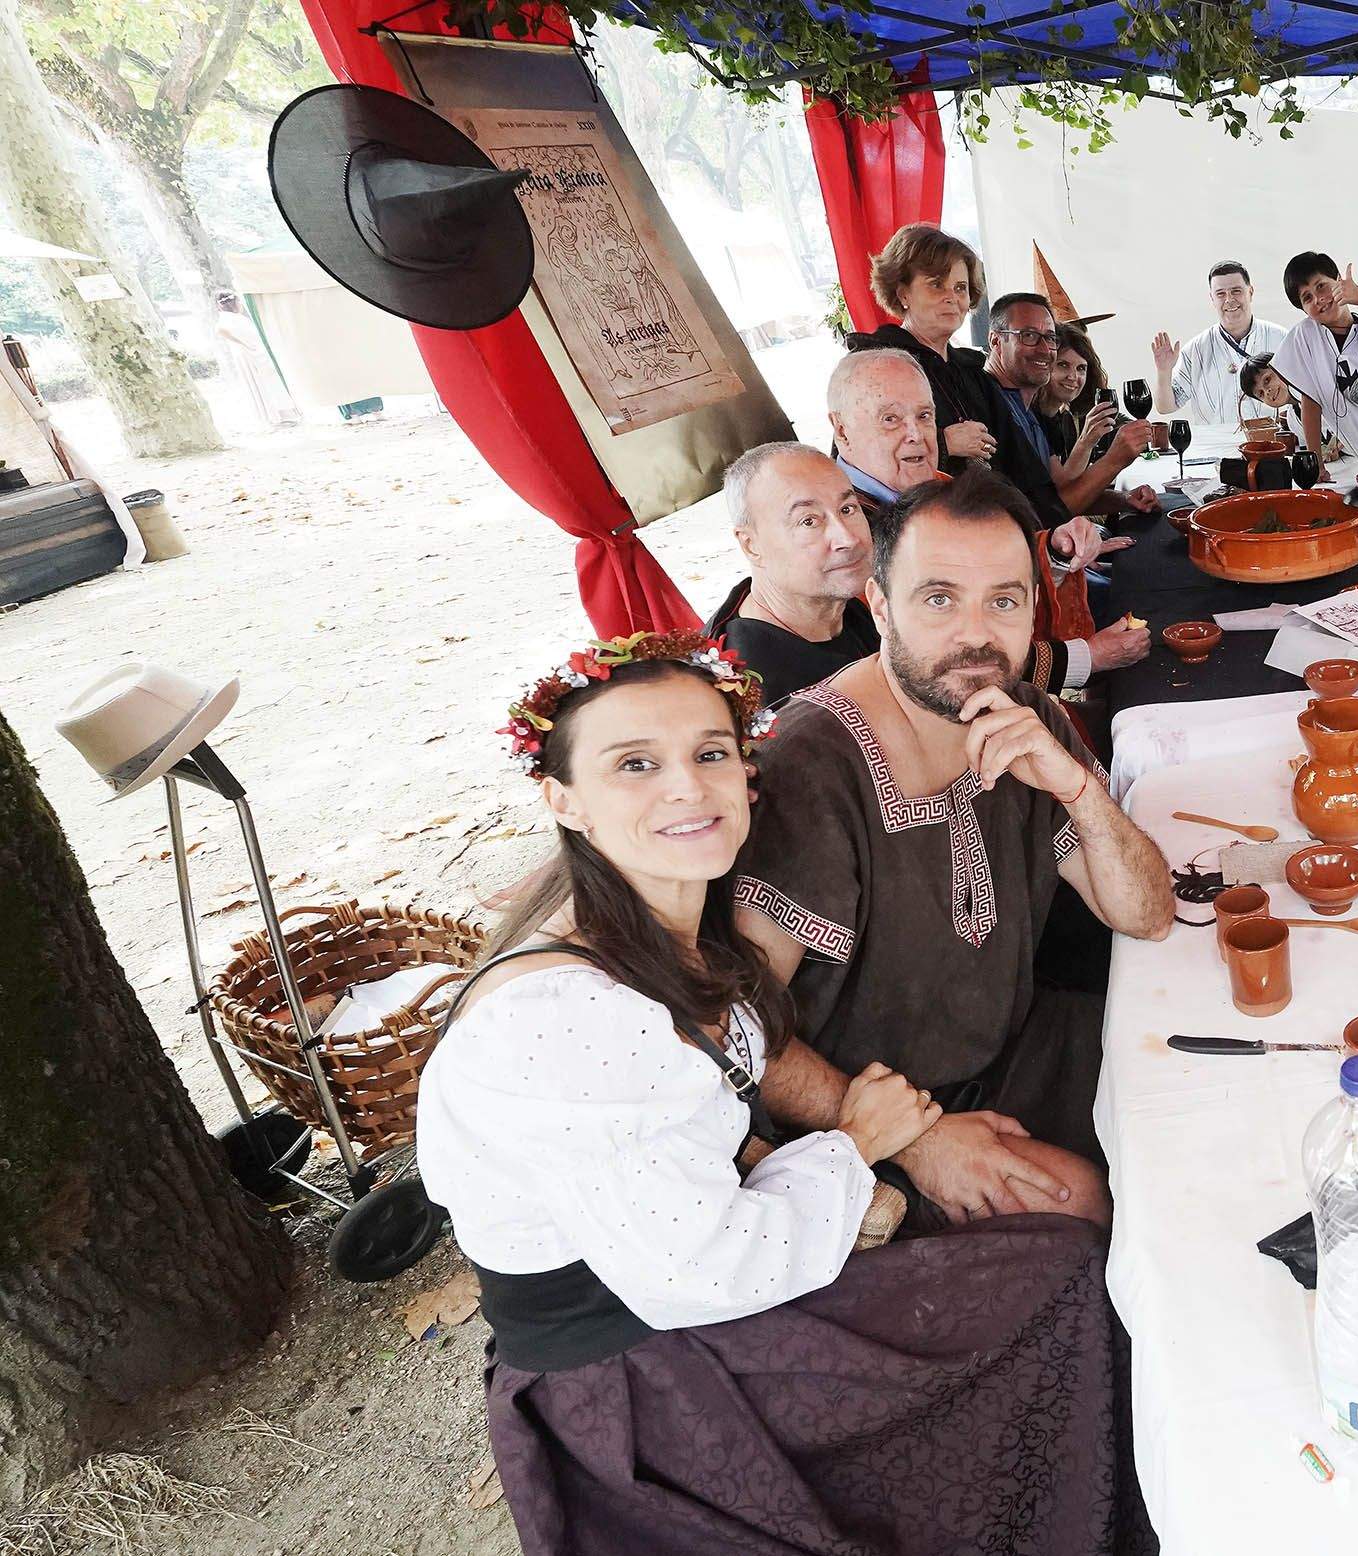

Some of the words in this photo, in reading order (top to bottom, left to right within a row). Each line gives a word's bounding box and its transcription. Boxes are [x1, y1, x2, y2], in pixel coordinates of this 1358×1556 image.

[554, 168, 608, 193] Franca
[601, 328, 624, 348] As
[625, 319, 670, 342] meigas
